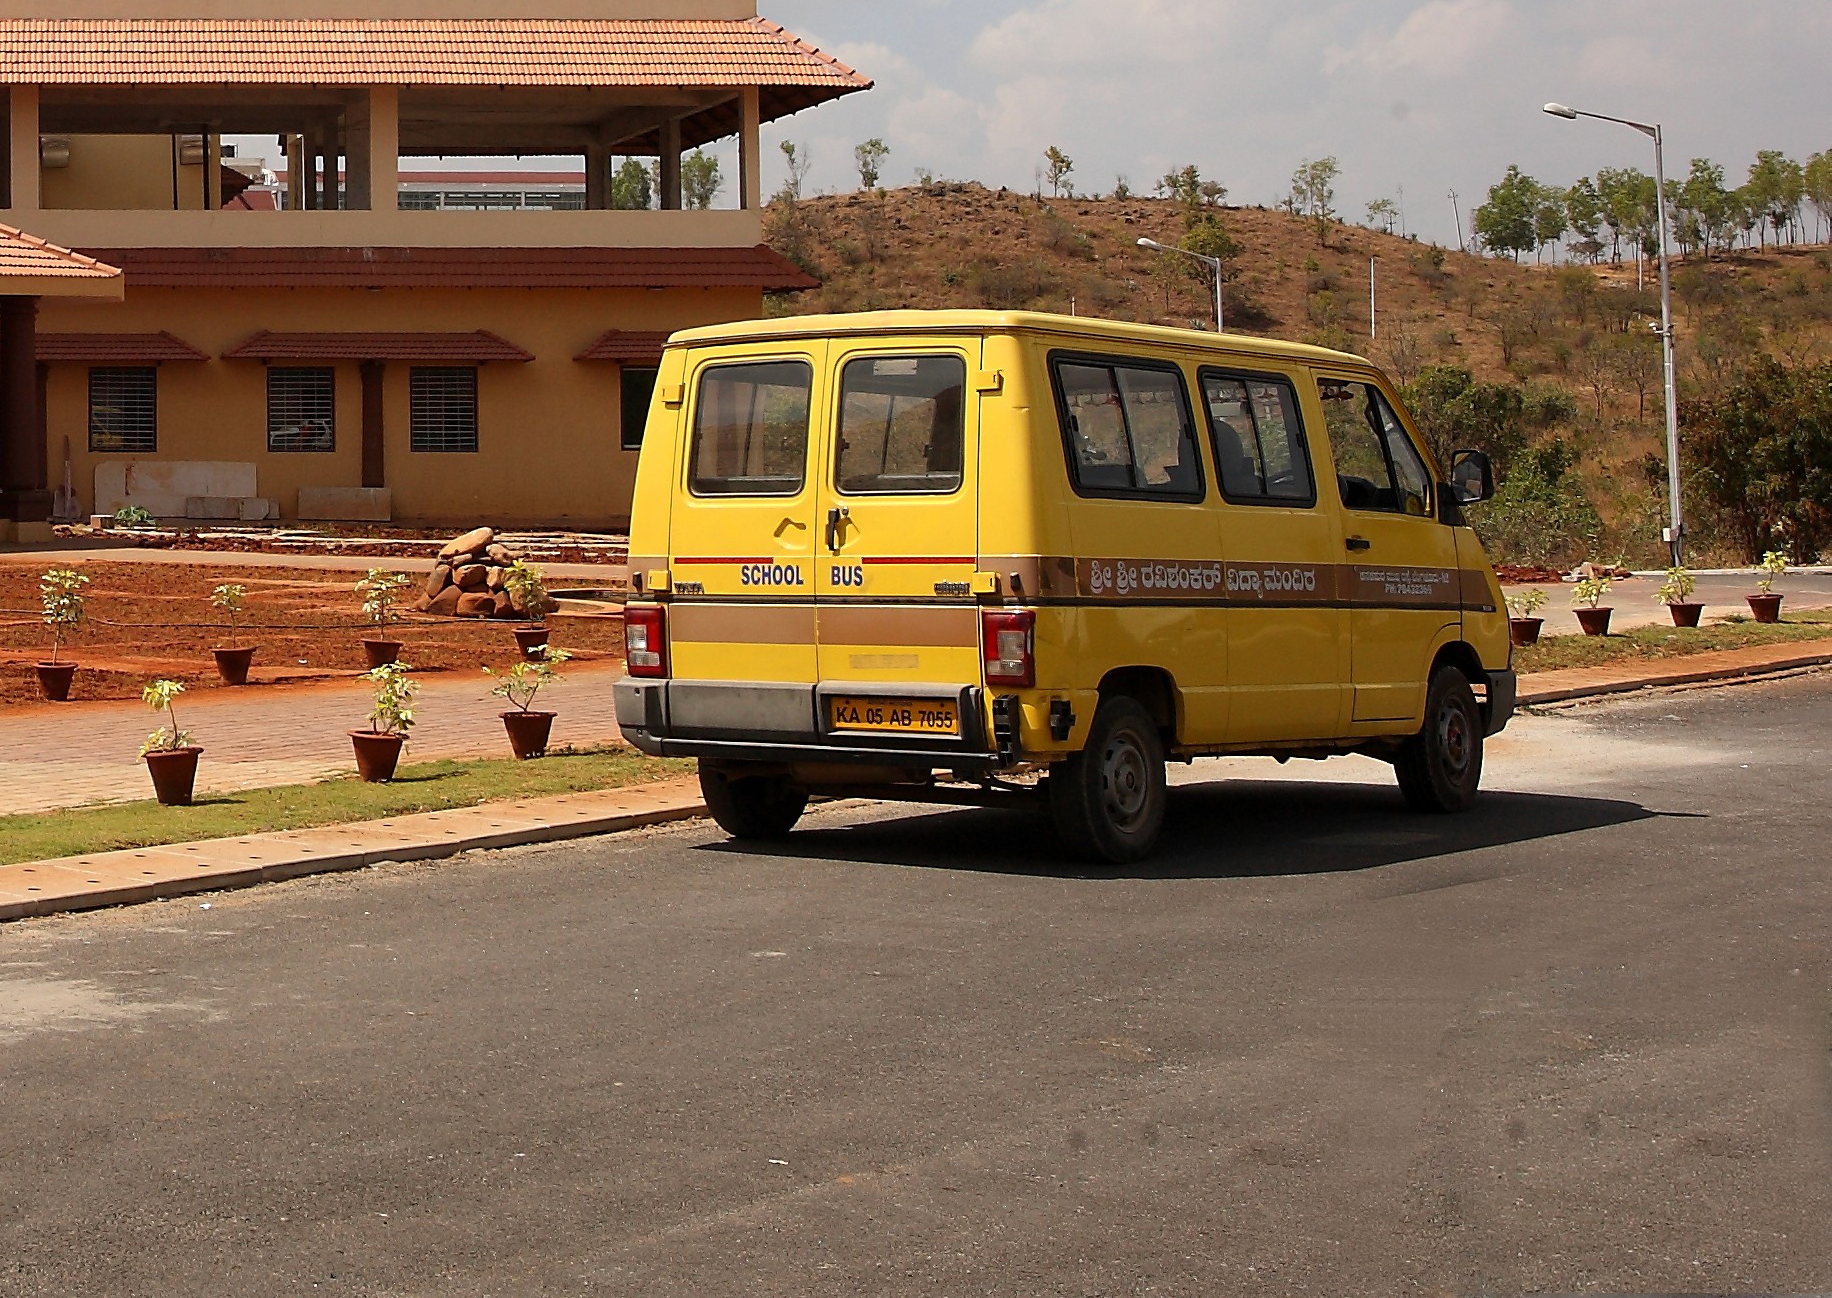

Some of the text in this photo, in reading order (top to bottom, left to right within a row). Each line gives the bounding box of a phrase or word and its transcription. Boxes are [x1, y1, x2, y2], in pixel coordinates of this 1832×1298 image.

[740, 563, 864, 587] SCHOOL BUS
[1090, 560, 1112, 594] ಶ್ರೀ
[1116, 561, 1138, 595] ಶ್ರೀ
[1140, 561, 1222, 591] ರವಿಶಂಕರ್
[836, 706, 953, 729] KA 05 AB 7055
